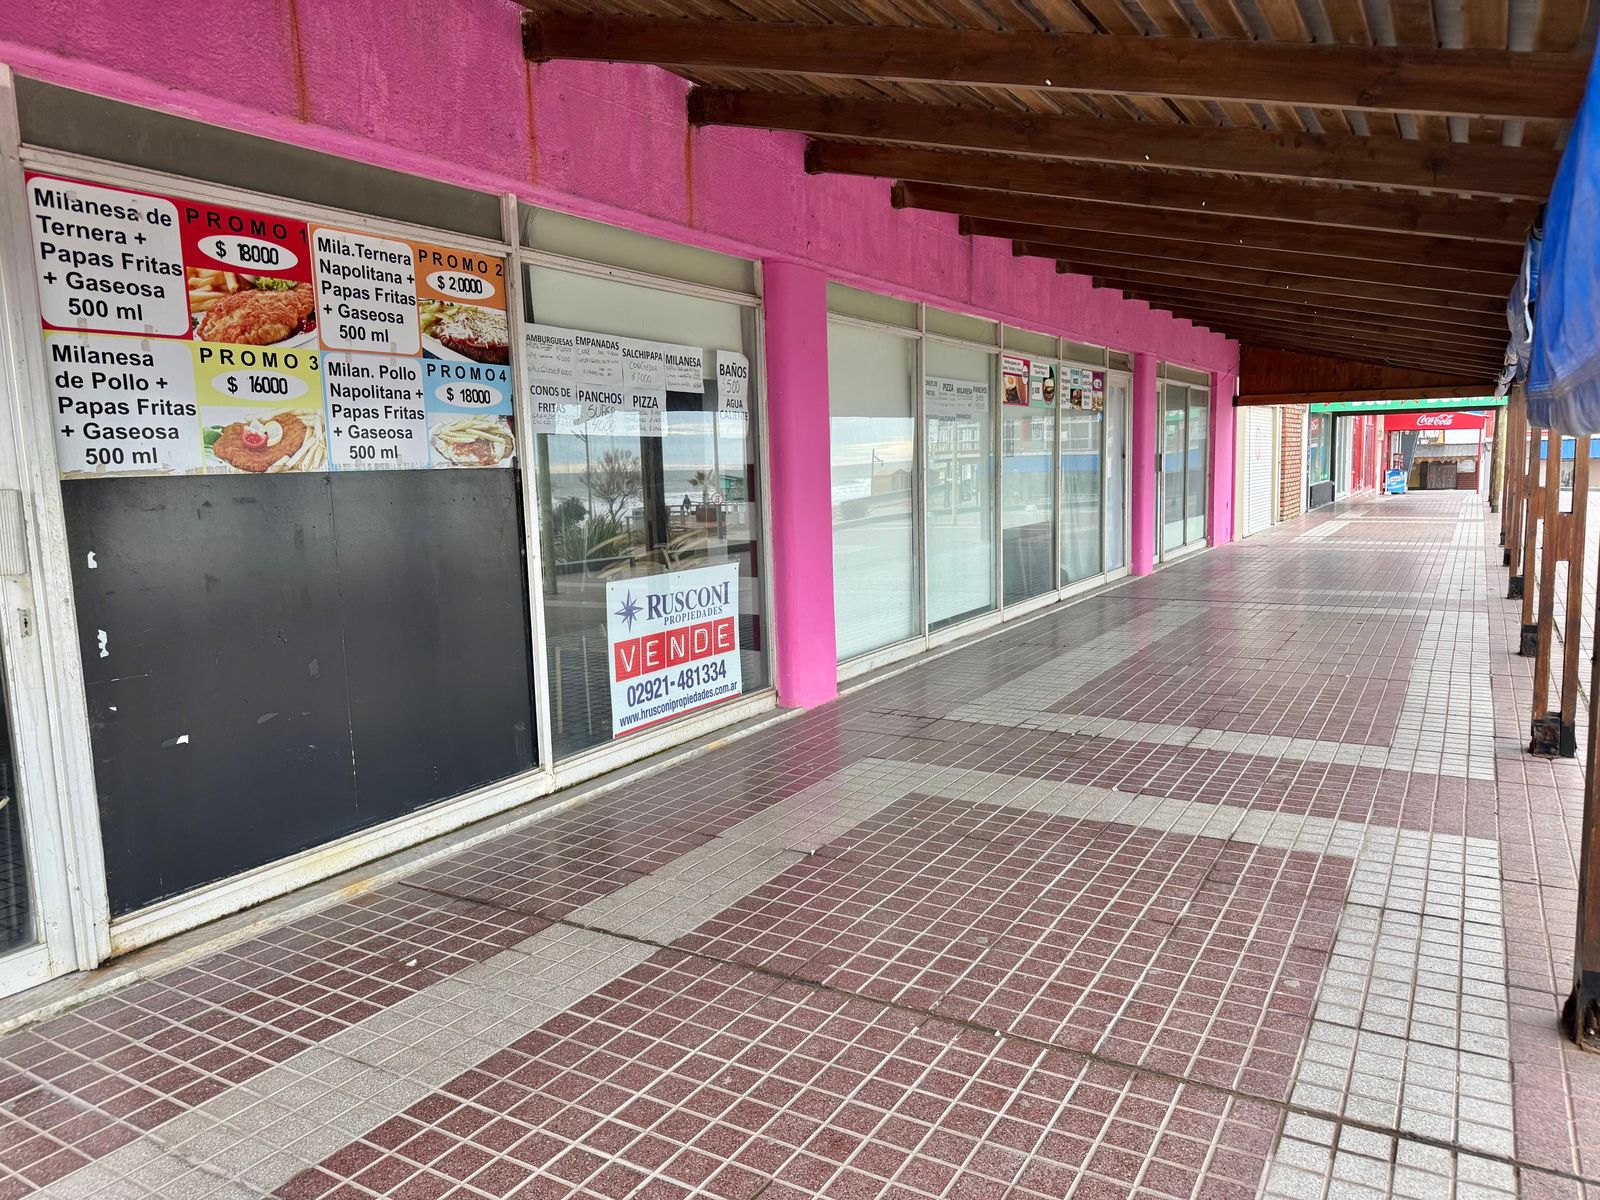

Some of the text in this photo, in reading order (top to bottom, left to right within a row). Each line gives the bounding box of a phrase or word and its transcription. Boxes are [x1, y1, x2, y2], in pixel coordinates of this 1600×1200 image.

[35, 188, 172, 226] Milanesa de
[37, 215, 126, 245] Ternera
[186, 208, 307, 243] PROMO 1
[40, 242, 183, 276] Papas Fritas
[215, 240, 278, 265] $ 18000
[320, 259, 401, 284] Napolitana
[419, 250, 502, 277] PROMO 2
[66, 272, 165, 298] Gaseosa
[438, 276, 445, 290] $
[322, 281, 416, 306] Papas Fritas
[69, 299, 142, 321] 500 ml
[338, 304, 404, 324] Gaseosa
[339, 325, 389, 342] 500 ml
[576, 336, 619, 350] EMPANADAS
[52, 344, 154, 366] Milanesa
[200, 348, 318, 370] PROMO 3
[622, 349, 663, 361] SALCHIPAPA
[666, 354, 701, 368] MILANESA
[328, 362, 416, 380] Milan. Pollo
[720, 363, 747, 379] BAÑOS
[55, 371, 83, 389] de
[92, 373, 149, 391] Pollo
[227, 376, 288, 394] $ 16000
[943, 383, 954, 392] PIZZA
[330, 383, 411, 401] Napolitana
[446, 387, 491, 404] $ 18000
[530, 385, 571, 398] CONOS DE
[579, 390, 622, 405] PANCHOS
[58, 397, 197, 418] Papas Fritas
[539, 403, 566, 413] FRITAS
[633, 396, 658, 408] PIZZA
[726, 398, 743, 408] AGUA
[332, 404, 424, 421] Papas Fritas
[83, 423, 179, 440] Gaseosa
[348, 425, 412, 439] Gaseosa
[86, 447, 157, 465] 500 ml
[350, 446, 398, 459] 500 ml
[646, 582, 730, 620] RUSCONI
[664, 606, 722, 626] PROPIEDADES
[621, 624, 729, 672] VENDE
[620, 681, 737, 727] www.hrusconipropiedades.com.ar
